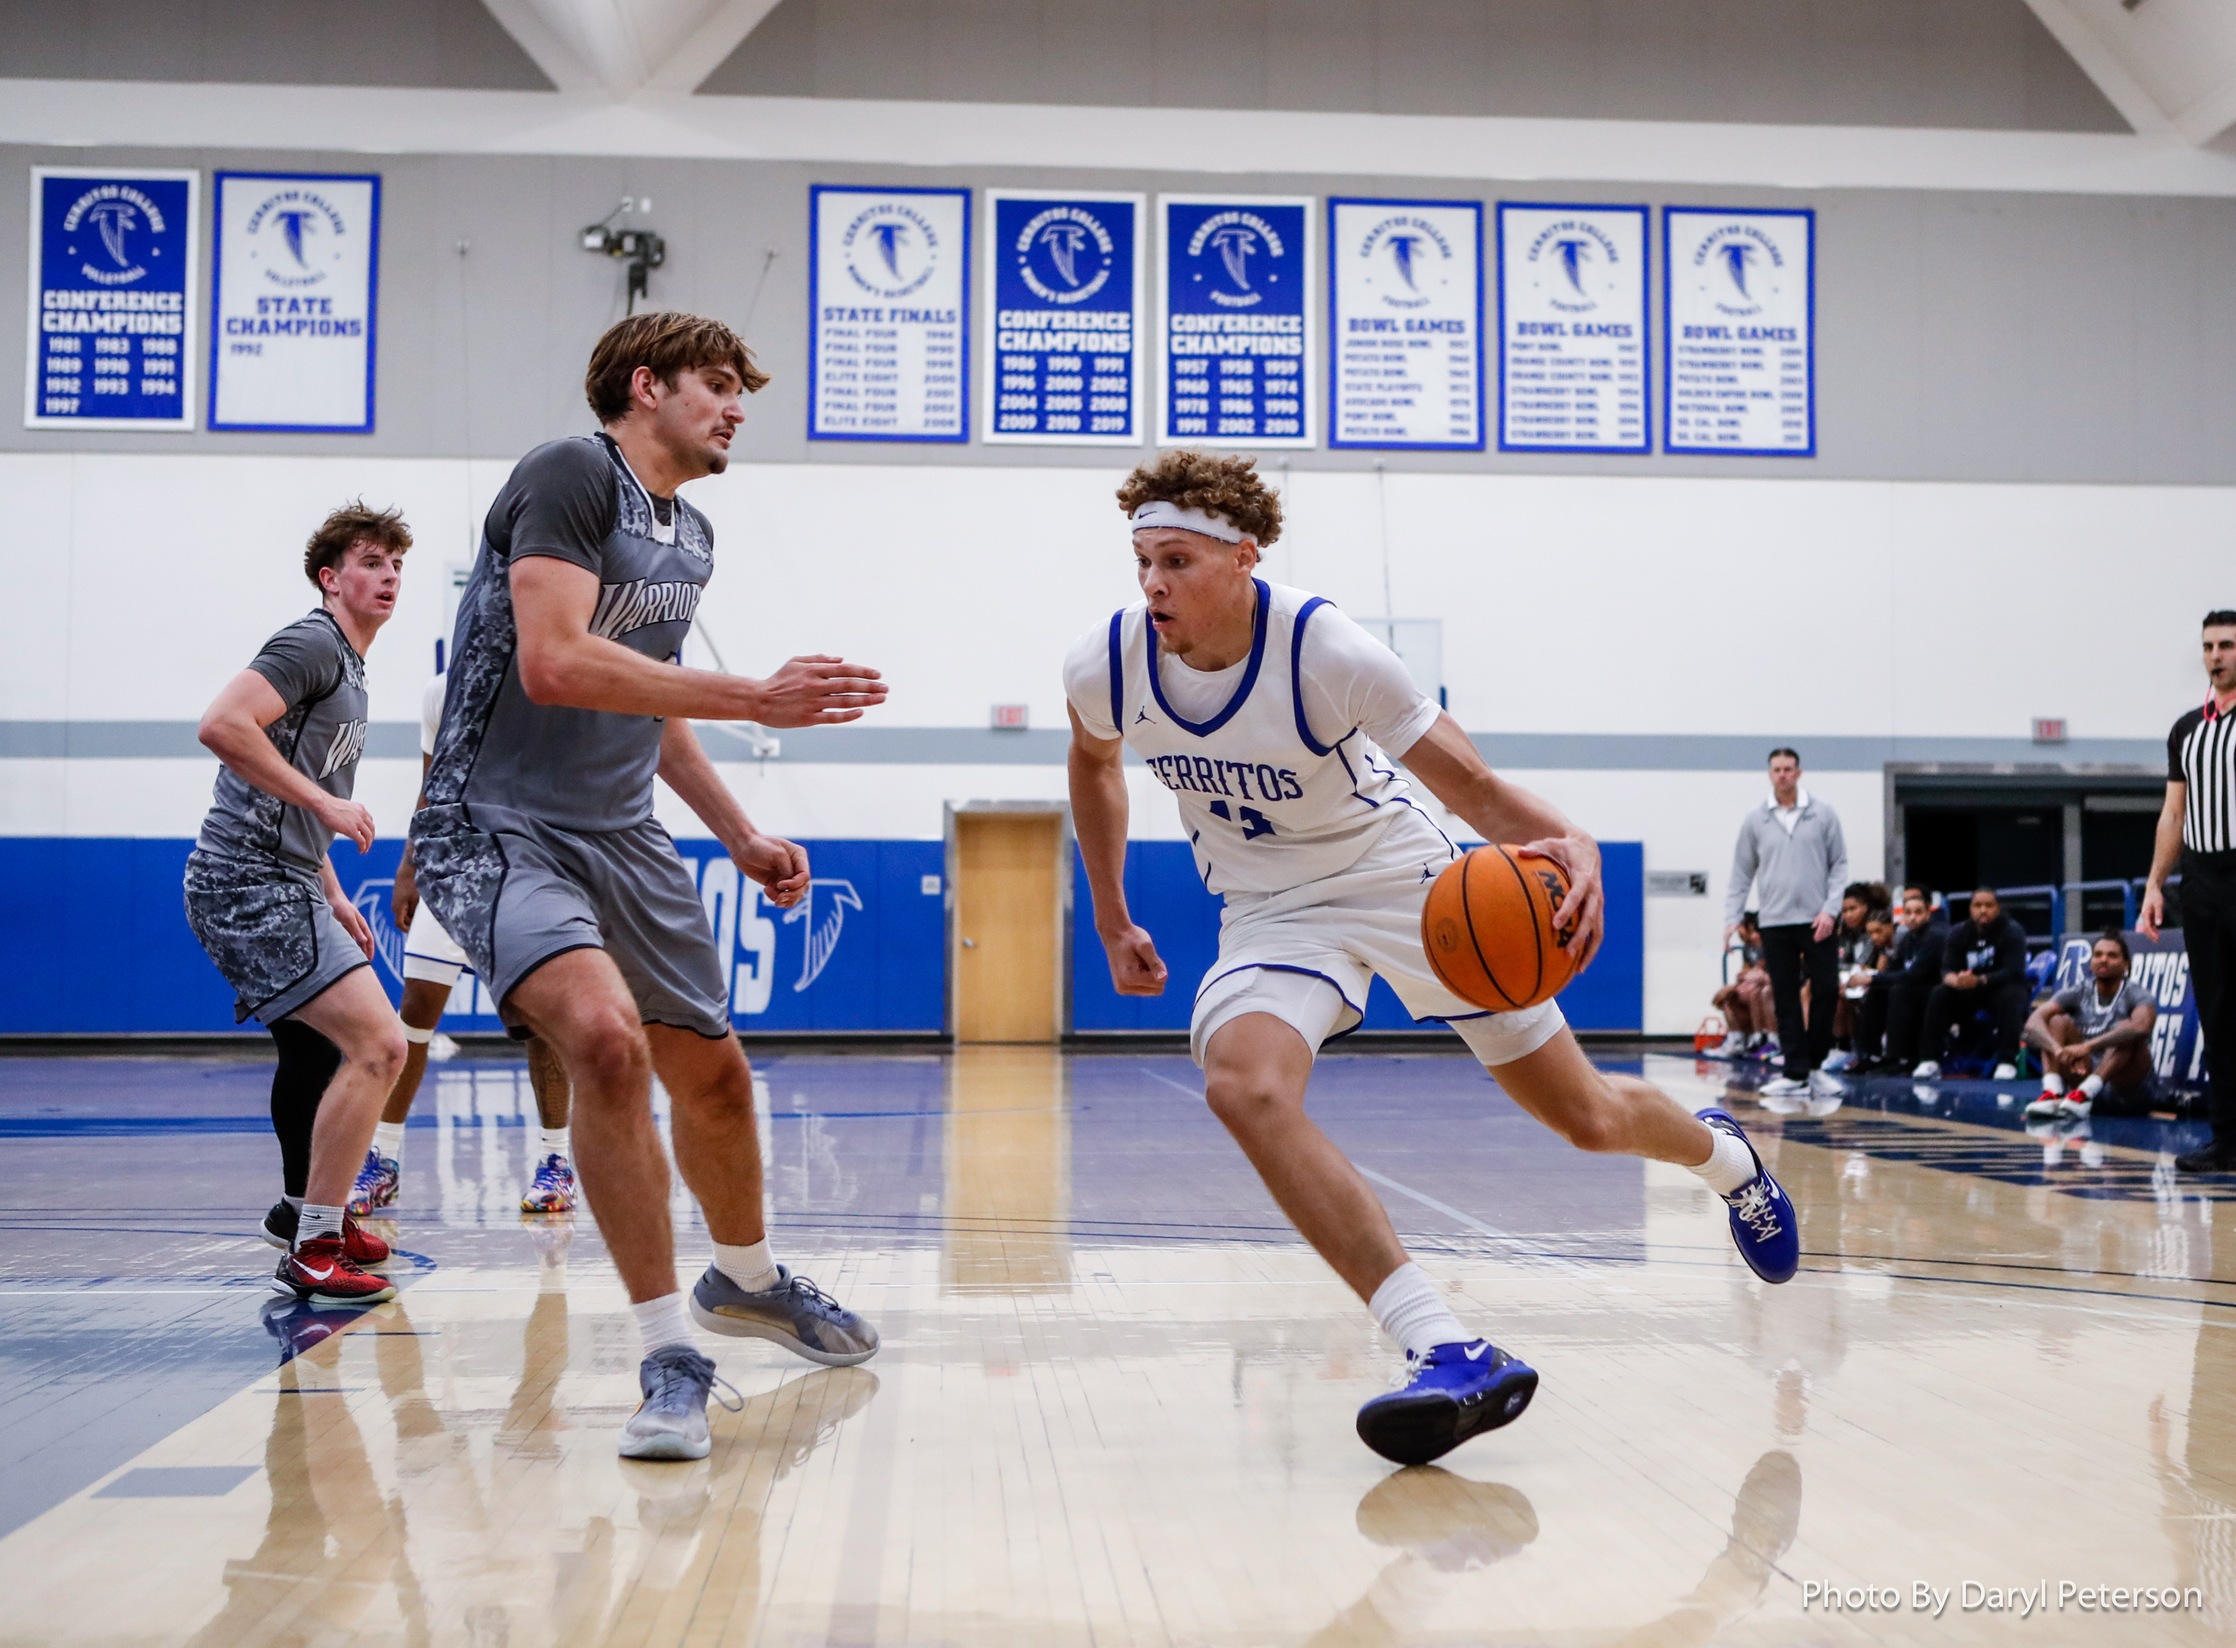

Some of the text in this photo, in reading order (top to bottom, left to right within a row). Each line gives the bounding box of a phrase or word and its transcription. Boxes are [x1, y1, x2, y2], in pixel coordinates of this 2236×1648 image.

[43, 290, 182, 311] CONFERENCE
[258, 297, 331, 314] STATE
[43, 311, 182, 334] CHAMPIONS
[824, 308, 955, 323] STATE FINALS
[999, 310, 1133, 330] CONFERENCE
[227, 319, 361, 335] CHAMPIONS
[1171, 314, 1304, 333] CONFERENCE
[1349, 319, 1465, 333] BOWL GAMES
[1518, 322, 1632, 337] BOWL GAMES
[825, 328, 898, 339] FINAL FOUR
[1683, 326, 1796, 341] BOWL GAMES
[825, 343, 898, 353] FINAL FOUR
[998, 331, 1133, 352] CHAMPIONS
[1170, 334, 1303, 356] CHAMPIONS
[825, 358, 859, 367] FINAL
[865, 359, 898, 368] FOUR
[825, 372, 857, 381] ELITE
[863, 374, 899, 383] EIGHT
[825, 387, 857, 396] FINAL
[865, 388, 898, 397] FOUR
[825, 402, 858, 411] FINAL
[865, 403, 897, 412] FOUR
[824, 416, 856, 426] ELITE
[862, 417, 897, 426] EIGHT
